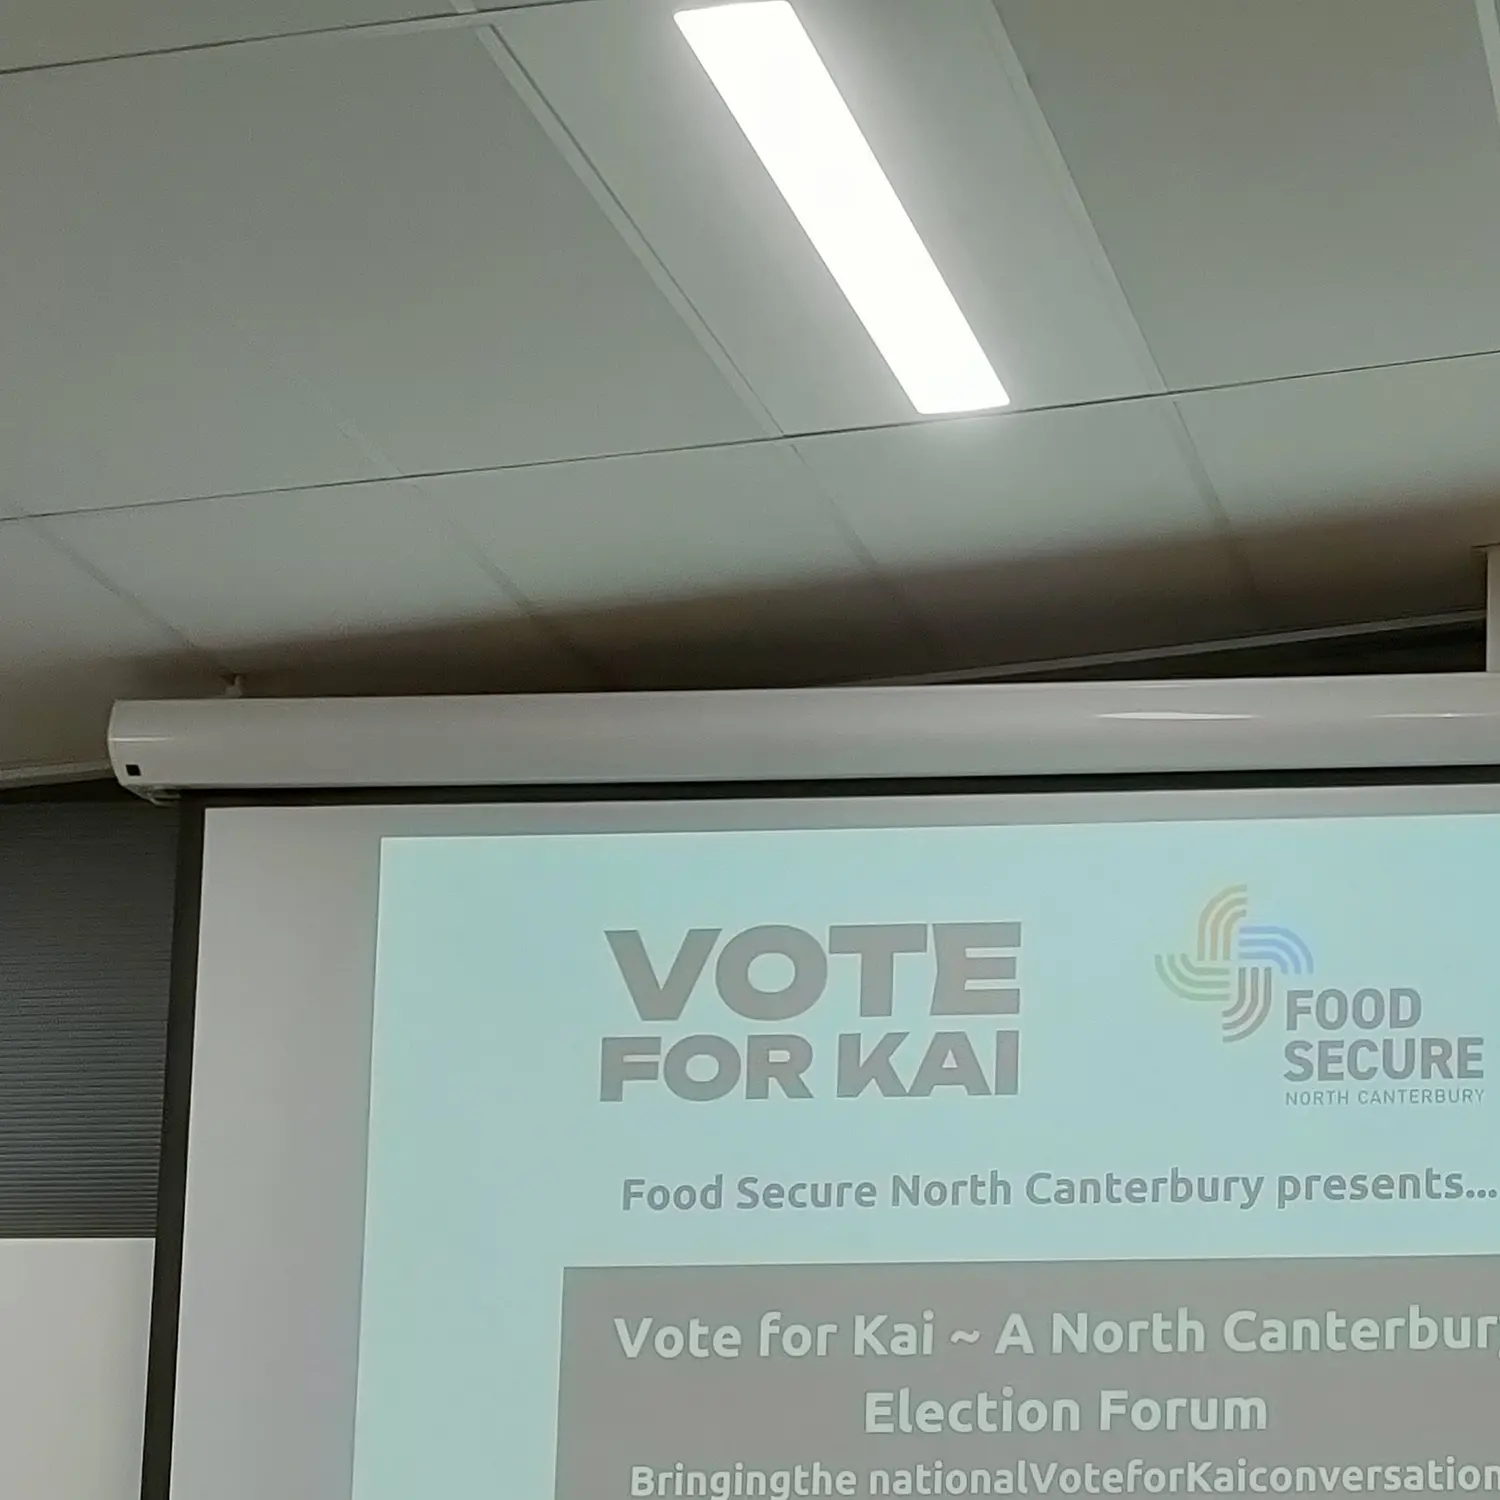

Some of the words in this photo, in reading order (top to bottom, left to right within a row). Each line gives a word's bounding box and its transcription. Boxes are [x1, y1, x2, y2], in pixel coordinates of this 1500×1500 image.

[603, 921, 1023, 1022] VOTE
[1286, 987, 1423, 1032] FOOD
[599, 1034, 815, 1103] FOR
[836, 1029, 1021, 1099] KAI
[1283, 1036, 1486, 1082] SECURE
[1284, 1089, 1350, 1106] NORTH
[1356, 1087, 1486, 1106] CANTERBURY
[622, 1173, 723, 1212] Food
[736, 1174, 878, 1210] Secure
[891, 1169, 1013, 1207] North
[1025, 1164, 1265, 1210] Canterbury
[1276, 1166, 1499, 1211] presents...
[613, 1316, 742, 1359] Vote
[758, 1311, 839, 1357] for
[854, 1309, 935, 1356] Kai
[994, 1313, 1035, 1354] A
[1051, 1306, 1206, 1354] North
[865, 1386, 1081, 1434] Election
[1099, 1389, 1268, 1431] Forum
